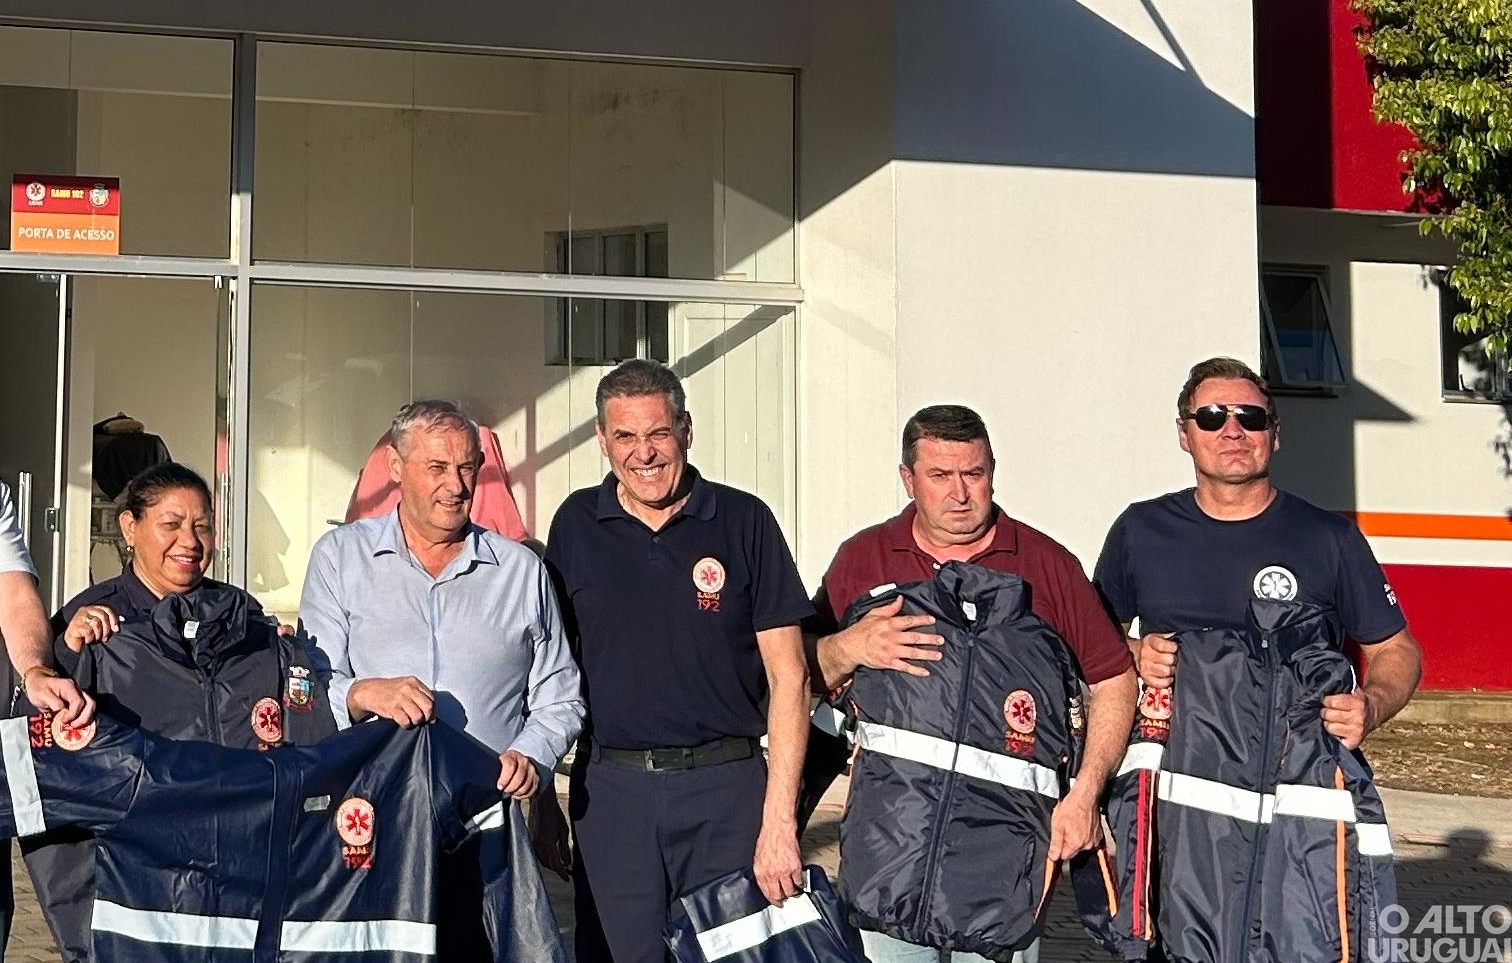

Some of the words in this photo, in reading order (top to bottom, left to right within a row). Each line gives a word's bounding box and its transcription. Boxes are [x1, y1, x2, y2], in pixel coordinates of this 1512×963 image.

[17, 226, 54, 239] PORTA
[56, 228, 72, 240] DE
[73, 229, 115, 241] ACESSO
[696, 599, 721, 612] 192
[29, 713, 44, 749] 192
[43, 711, 53, 748] SAMU
